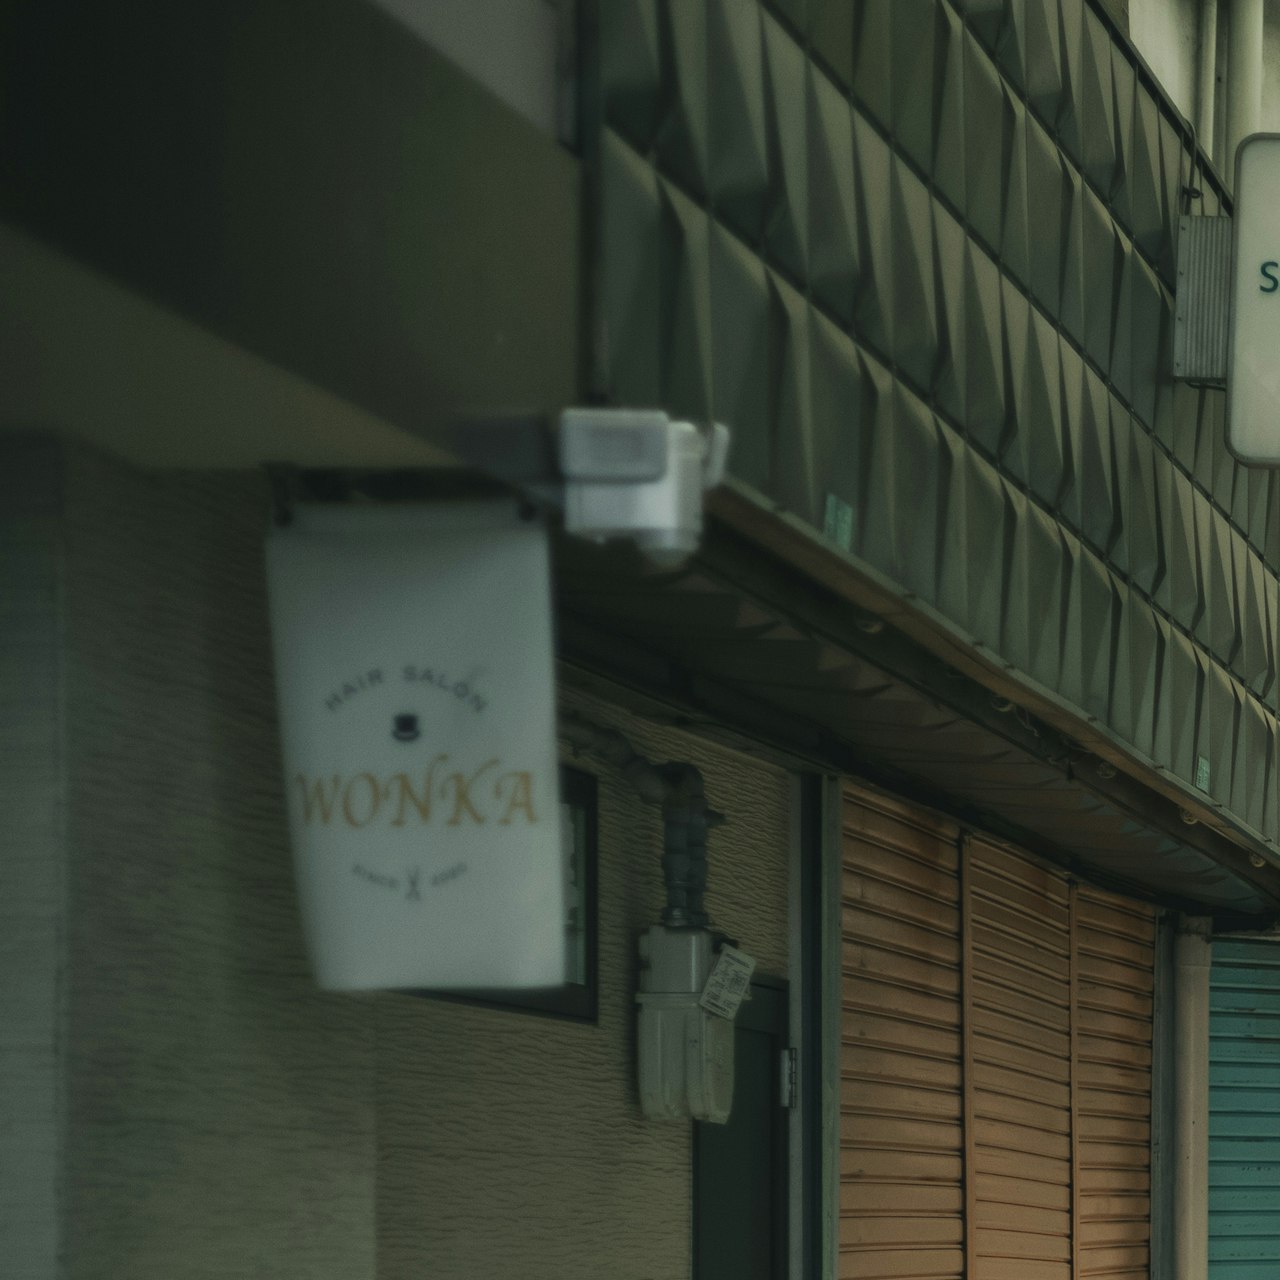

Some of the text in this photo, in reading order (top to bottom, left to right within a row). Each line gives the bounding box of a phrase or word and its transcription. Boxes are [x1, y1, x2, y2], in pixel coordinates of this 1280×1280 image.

[324, 664, 488, 713] HAIR SALON
[294, 751, 540, 828] WONKA
